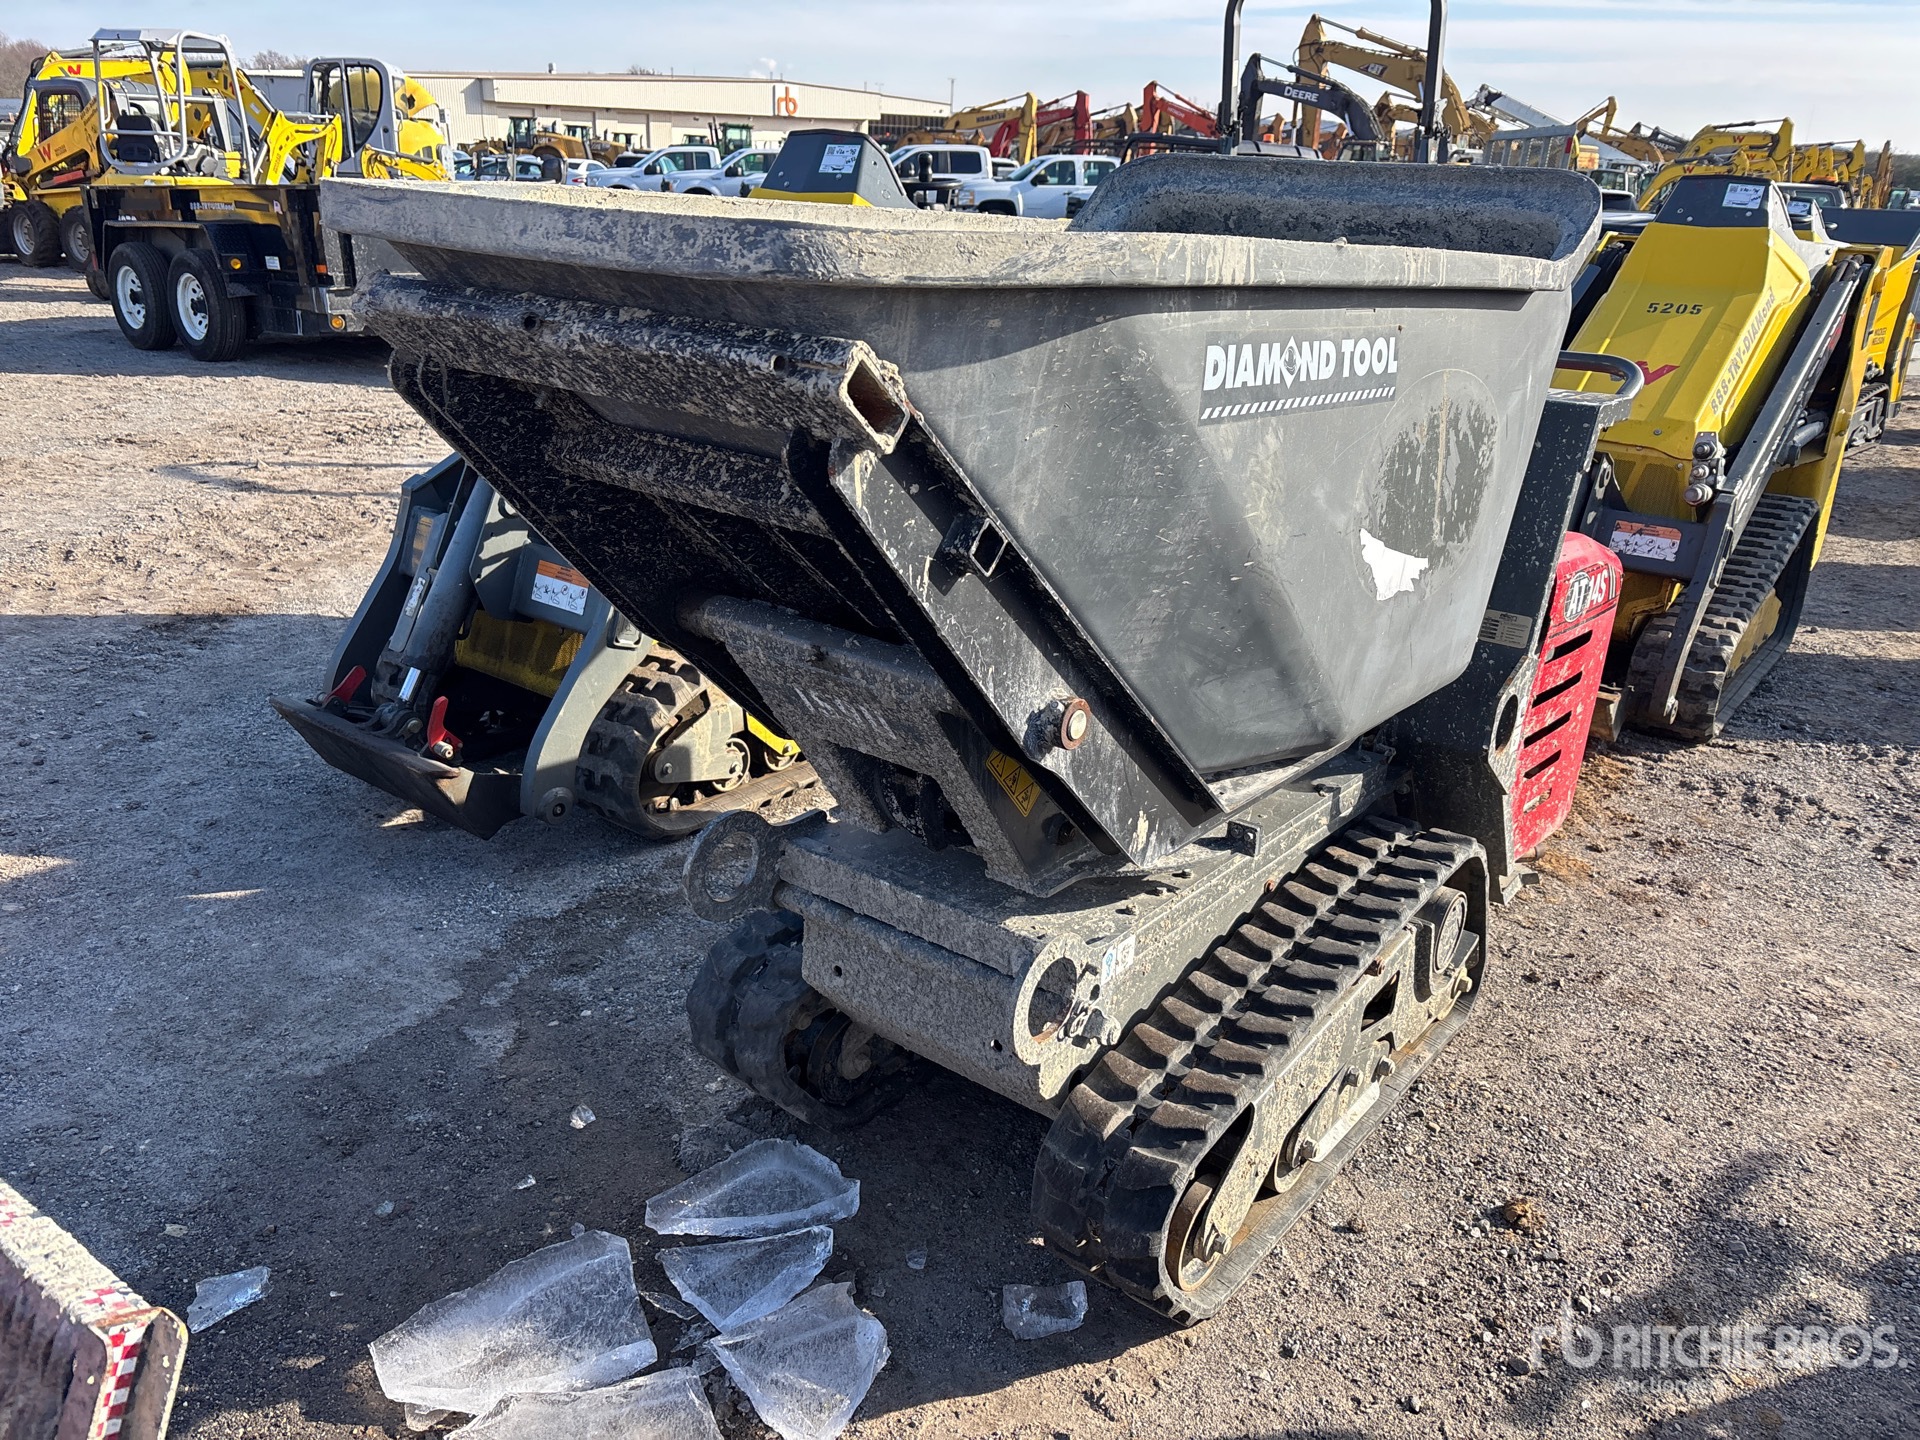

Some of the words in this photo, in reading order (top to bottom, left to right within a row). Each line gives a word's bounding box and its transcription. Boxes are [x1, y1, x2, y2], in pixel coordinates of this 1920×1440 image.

[1366, 64, 1385, 75] CAT
[777, 86, 798, 116] rb
[1284, 86, 1319, 102] DEERE
[1647, 302, 1703, 315] 5205
[1203, 336, 1337, 391] DIAMOND
[1341, 336, 1398, 378] TOOL
